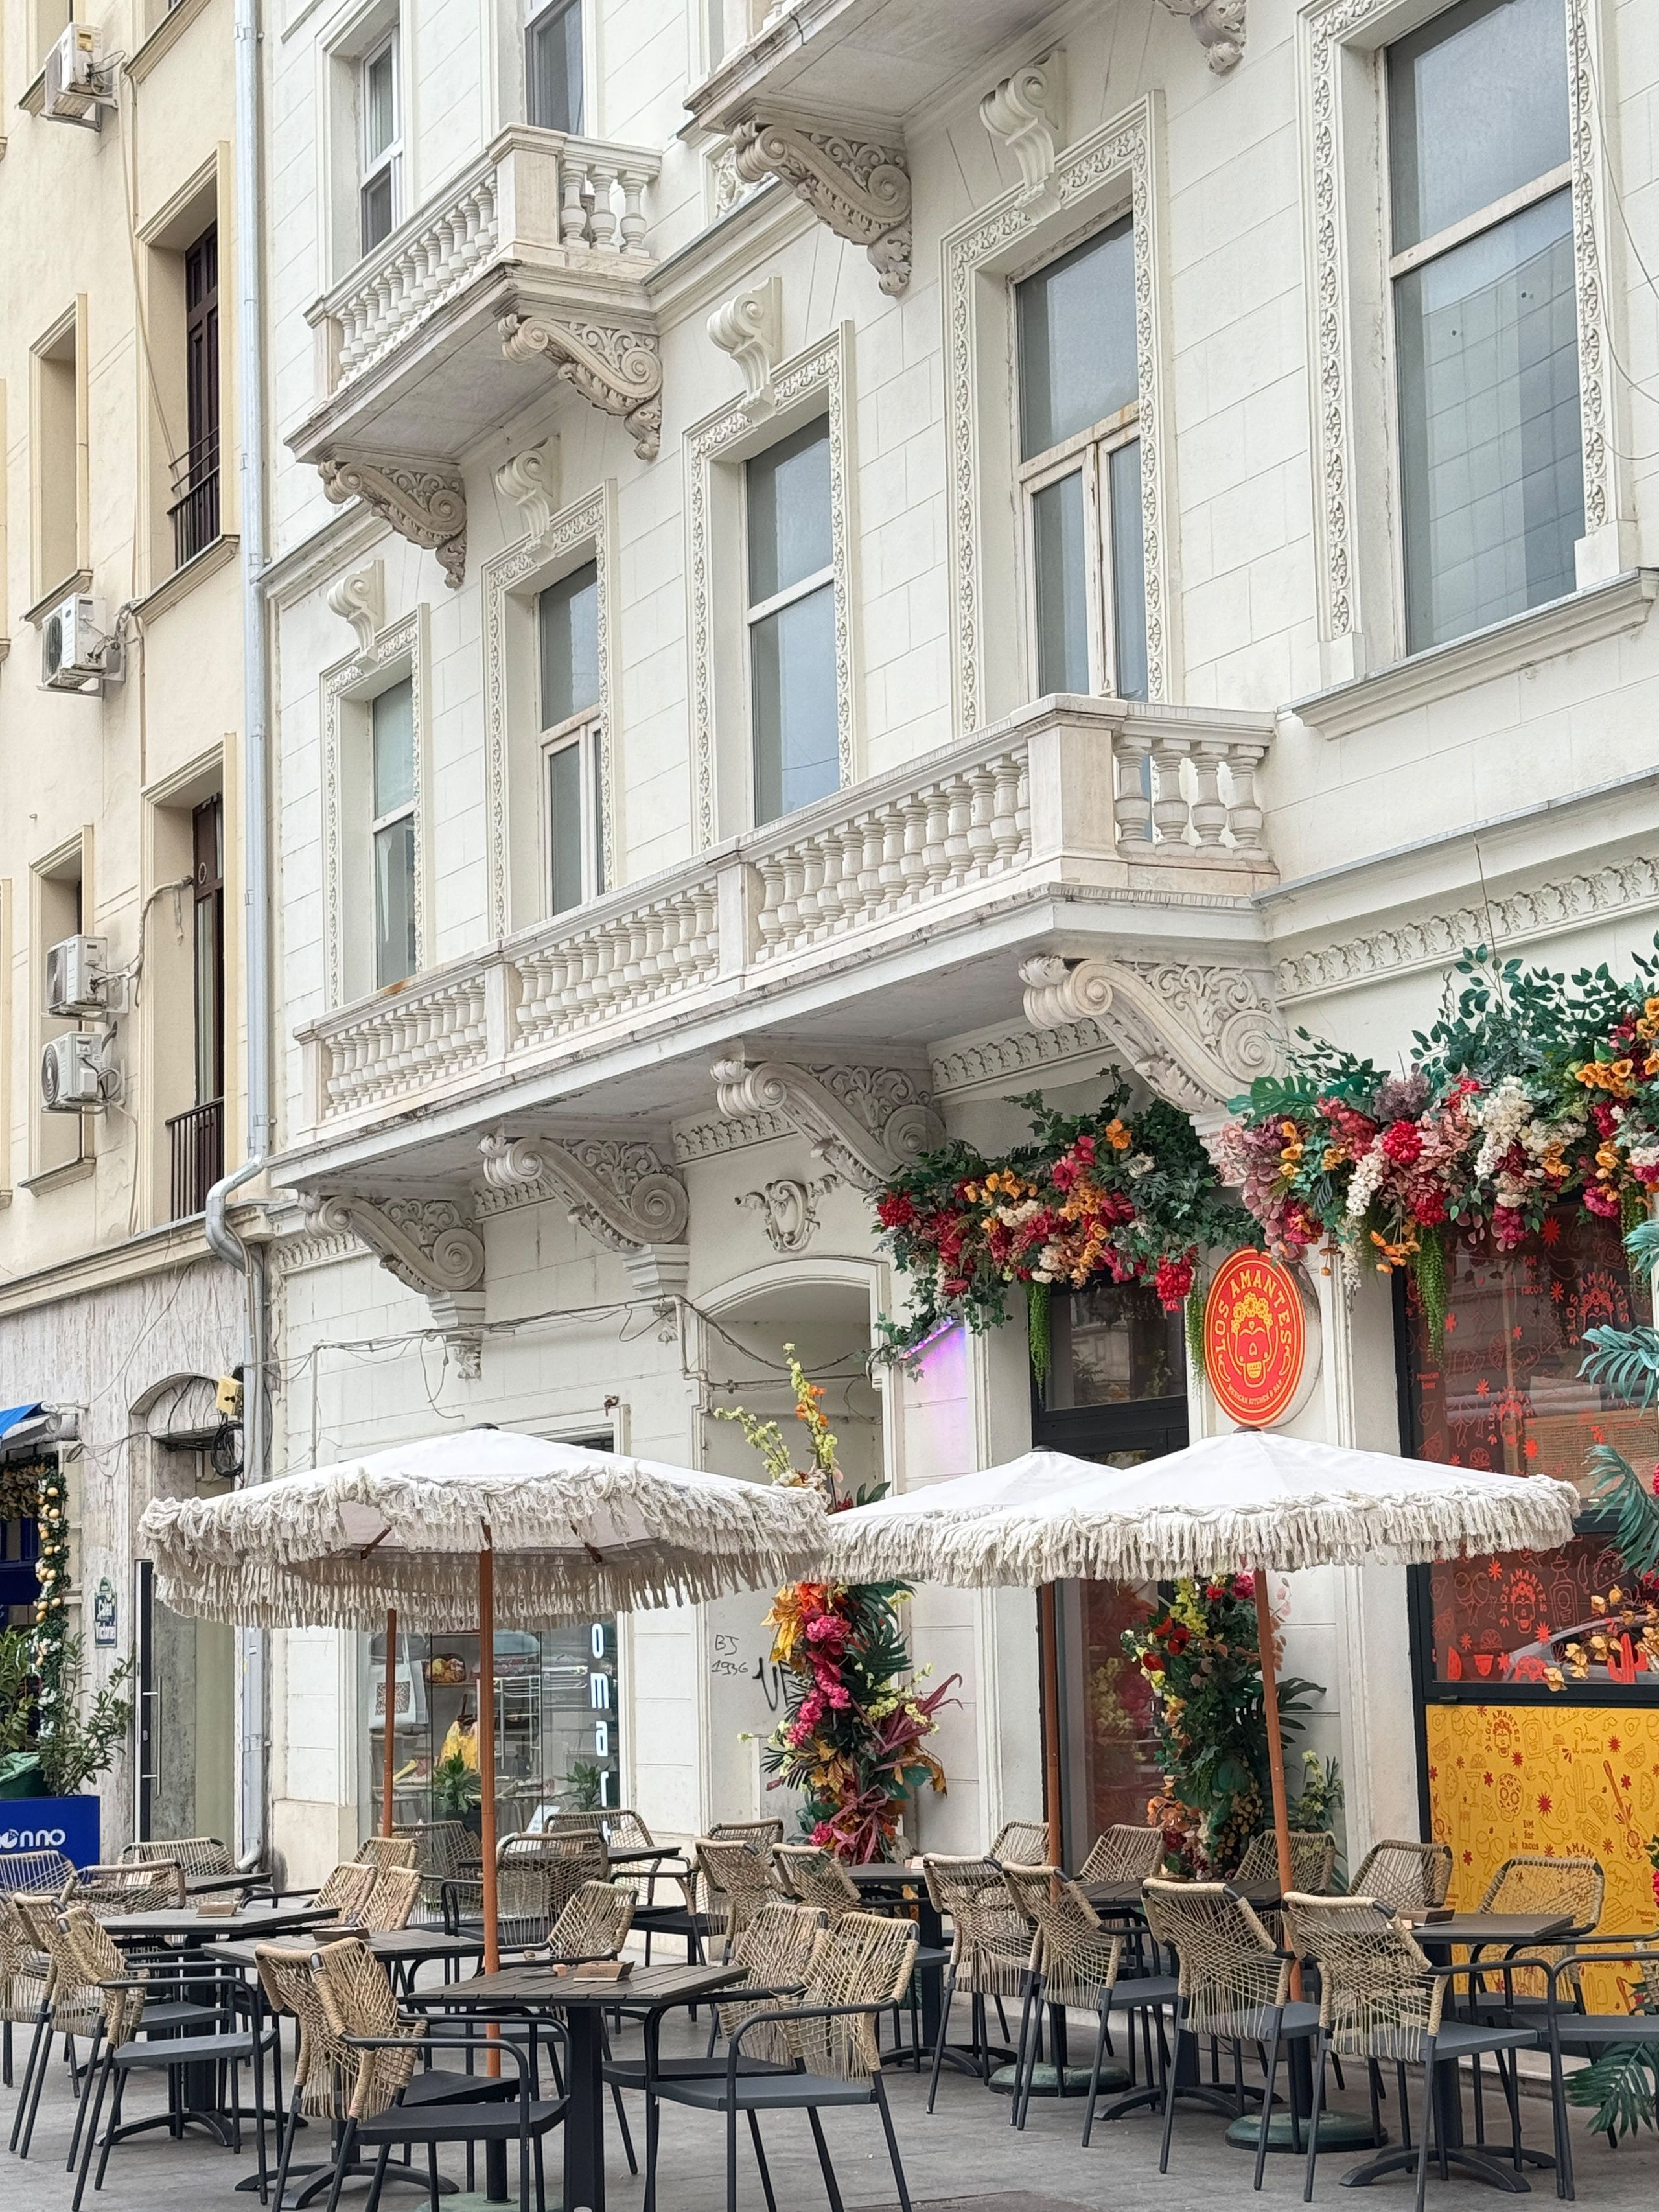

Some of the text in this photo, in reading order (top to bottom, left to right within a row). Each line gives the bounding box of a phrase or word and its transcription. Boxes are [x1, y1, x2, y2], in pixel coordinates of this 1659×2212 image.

[1214, 1269, 1293, 1353] LOS AMANTES
[1566, 1271, 1630, 1330] LOS AMANTES
[1500, 1568, 1548, 1612] LOS AMANTES
[1492, 1710, 1520, 1743] AMANTES
[1522, 1819, 1535, 1829] DM
[1524, 1830, 1535, 1839] for
[1521, 1841, 1539, 1850] tacos
